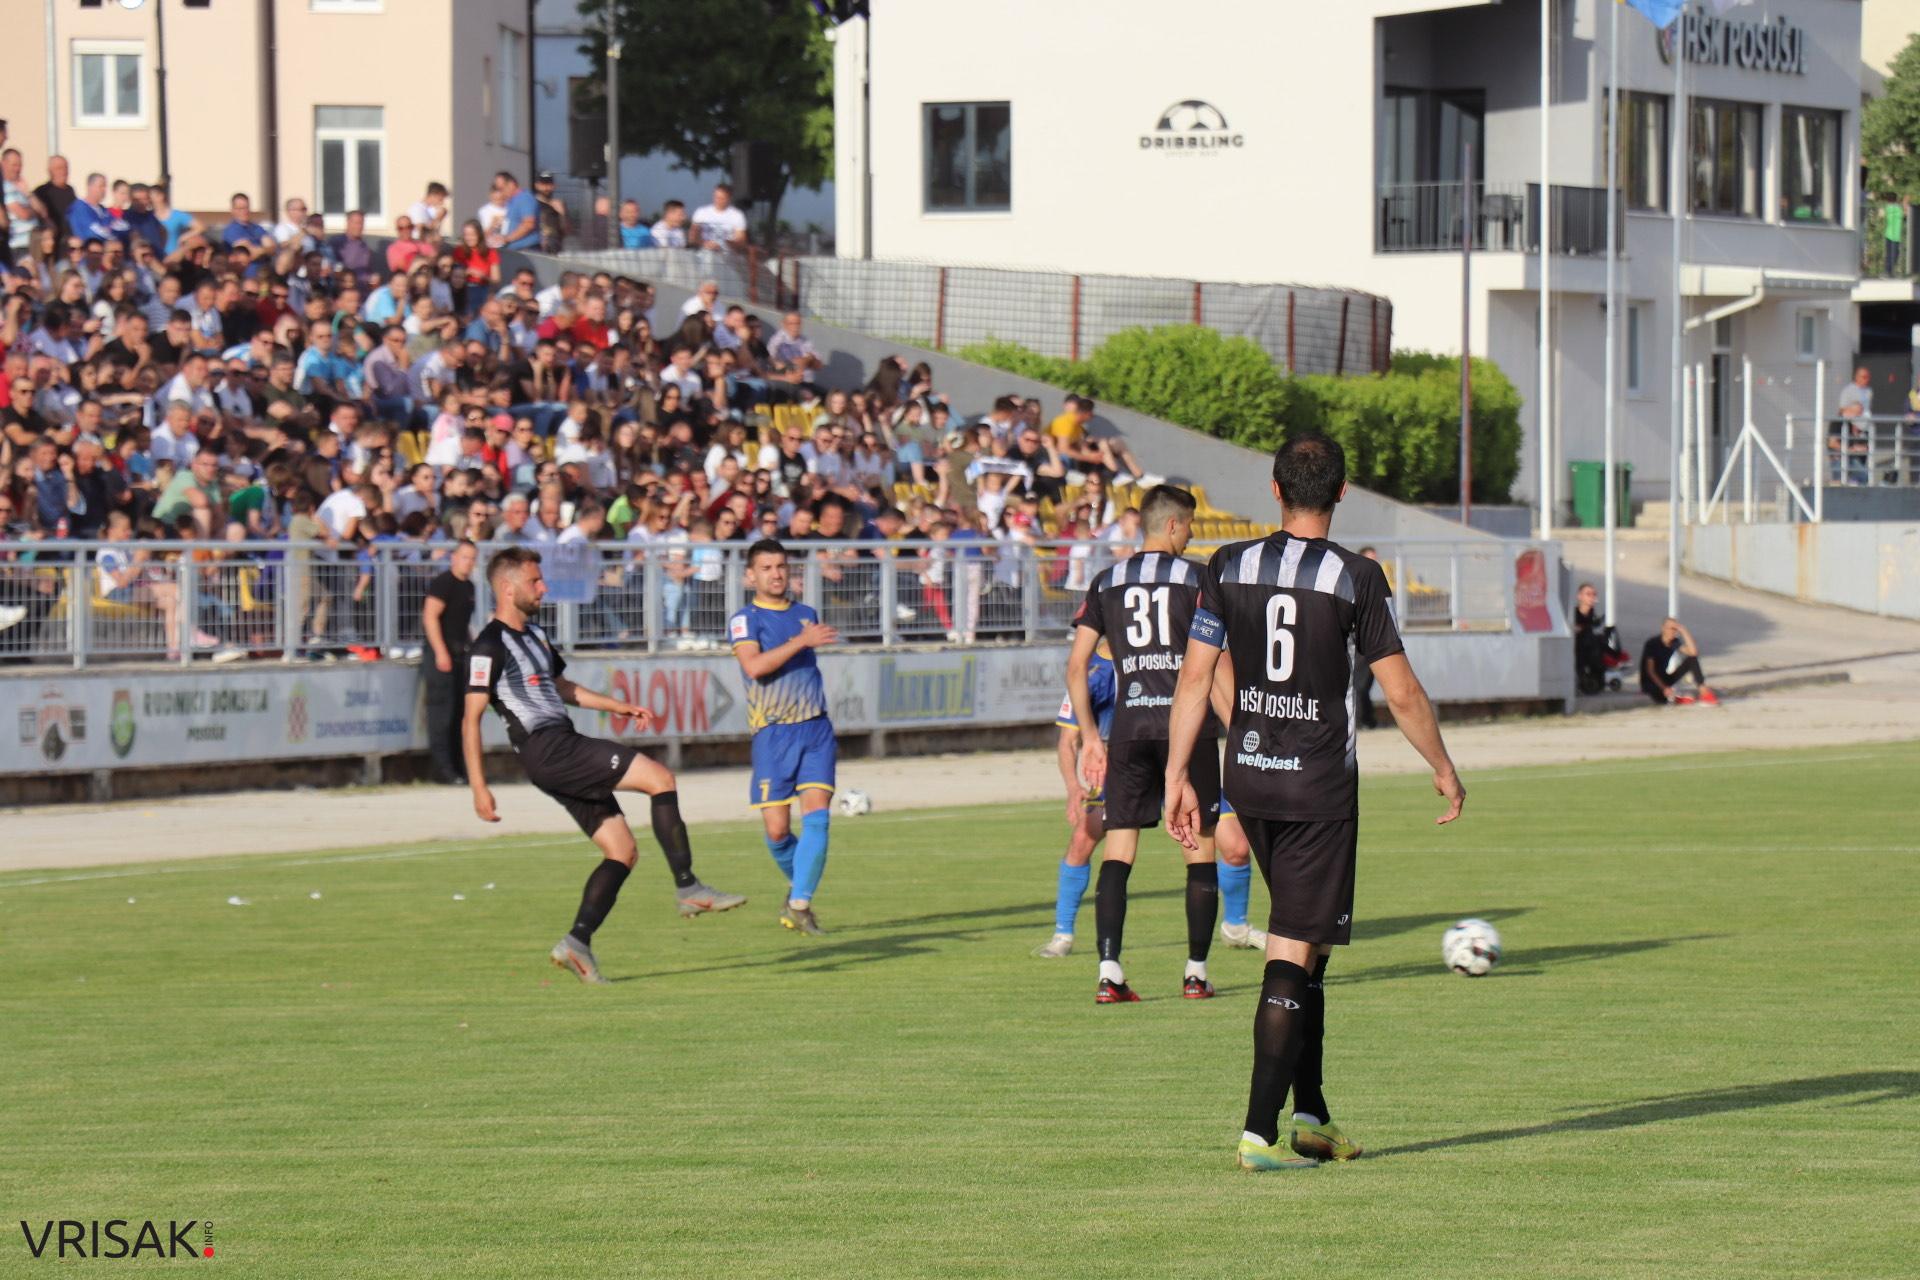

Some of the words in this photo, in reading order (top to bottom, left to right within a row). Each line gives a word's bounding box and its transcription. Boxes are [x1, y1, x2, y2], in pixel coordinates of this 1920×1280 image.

[1139, 134, 1244, 149] DRIBBLING
[1124, 586, 1170, 648] 31
[1266, 594, 1297, 682] 6
